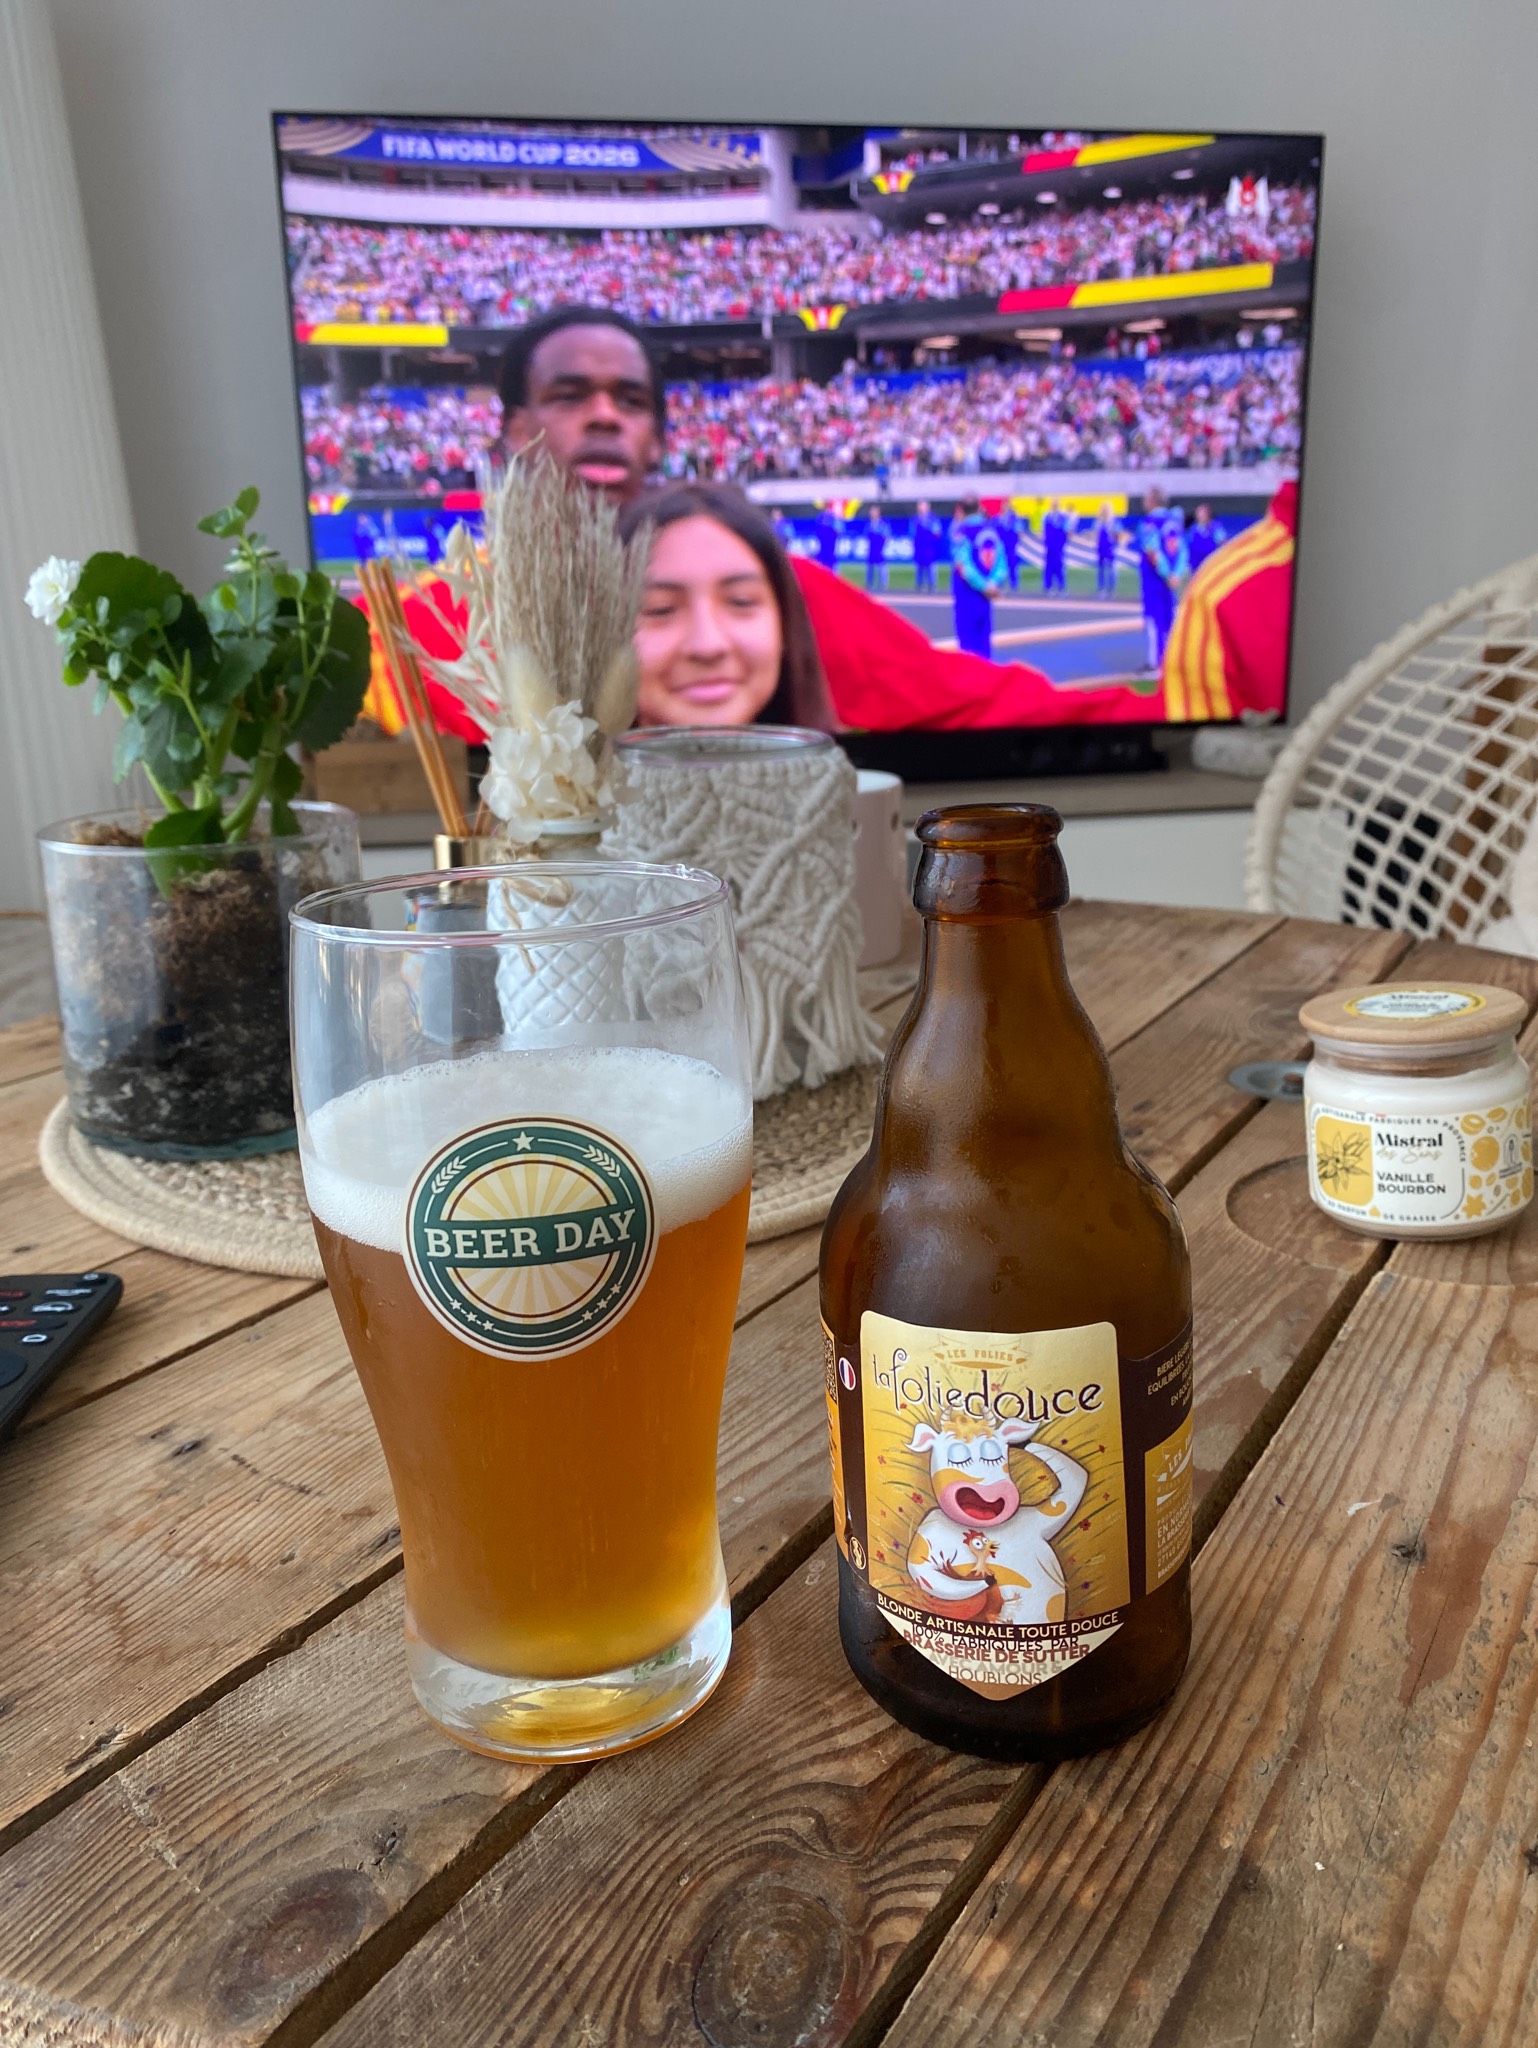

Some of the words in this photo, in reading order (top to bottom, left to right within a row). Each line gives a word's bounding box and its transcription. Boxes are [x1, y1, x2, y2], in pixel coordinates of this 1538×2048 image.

[381, 134, 434, 160] FIFA
[434, 137, 517, 163] WORLD
[518, 141, 562, 165] CUP
[563, 143, 640, 167] 2026
[1376, 1132, 1443, 1147] Mistral
[1377, 1171, 1434, 1183] VANILLE
[1377, 1183, 1446, 1195] BOURBON
[424, 1227, 541, 1259] BEER
[554, 1208, 636, 1253] DAY
[946, 1349, 967, 1359] LES
[974, 1349, 1014, 1362] FOLIES
[877, 1593, 923, 1624] BLONDE
[926, 1616, 1015, 1639] ARTISANALE
[1018, 1624, 1067, 1639] TOUTE
[1071, 1611, 1120, 1633] DOUCE
[903, 1629, 991, 1662] BRASSERIE
[995, 1648, 1020, 1663] DE
[1022, 1643, 1091, 1664] SUTTER
[1051, 1636, 1079, 1649] PAR
[948, 1665, 1042, 1686] HOUBLONS
